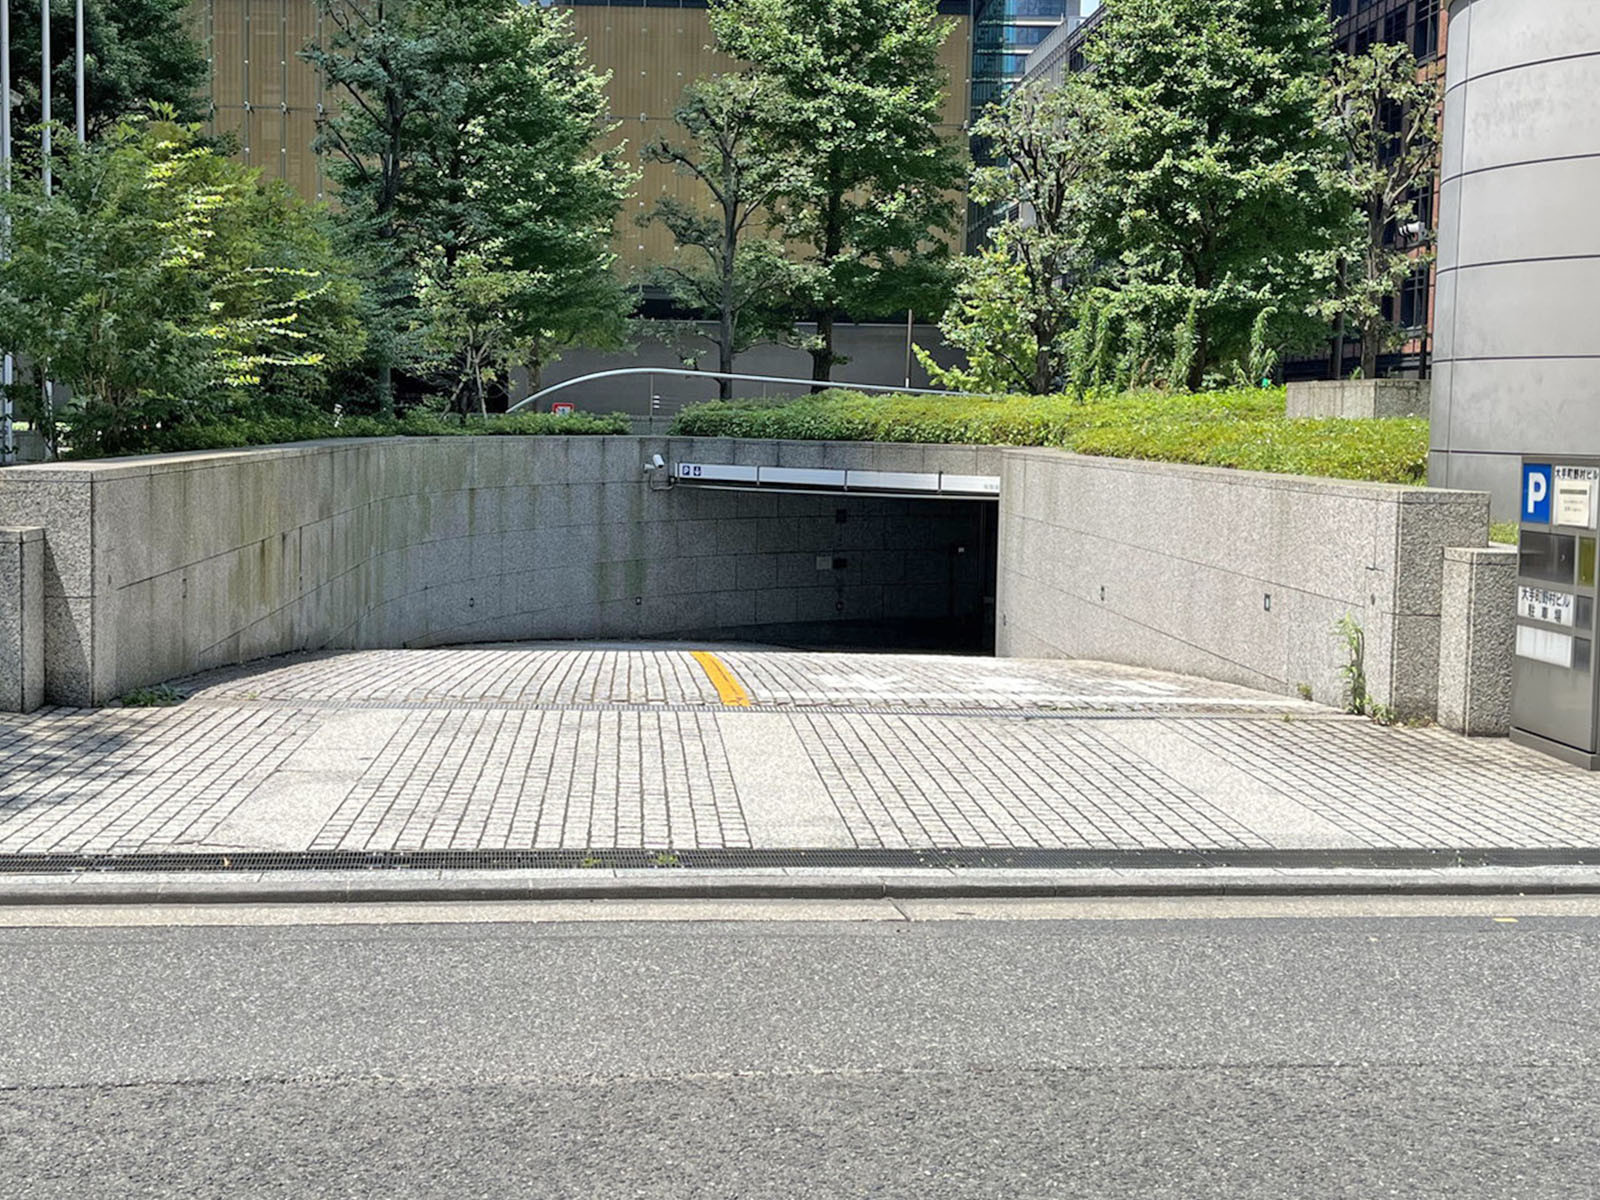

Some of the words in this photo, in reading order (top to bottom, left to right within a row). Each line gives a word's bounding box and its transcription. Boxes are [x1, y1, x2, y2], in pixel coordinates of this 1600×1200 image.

[1555, 468, 1598, 480] 大手町野村ビル
[1528, 472, 1546, 513] P
[1521, 588, 1570, 607] 大手町野村ビル
